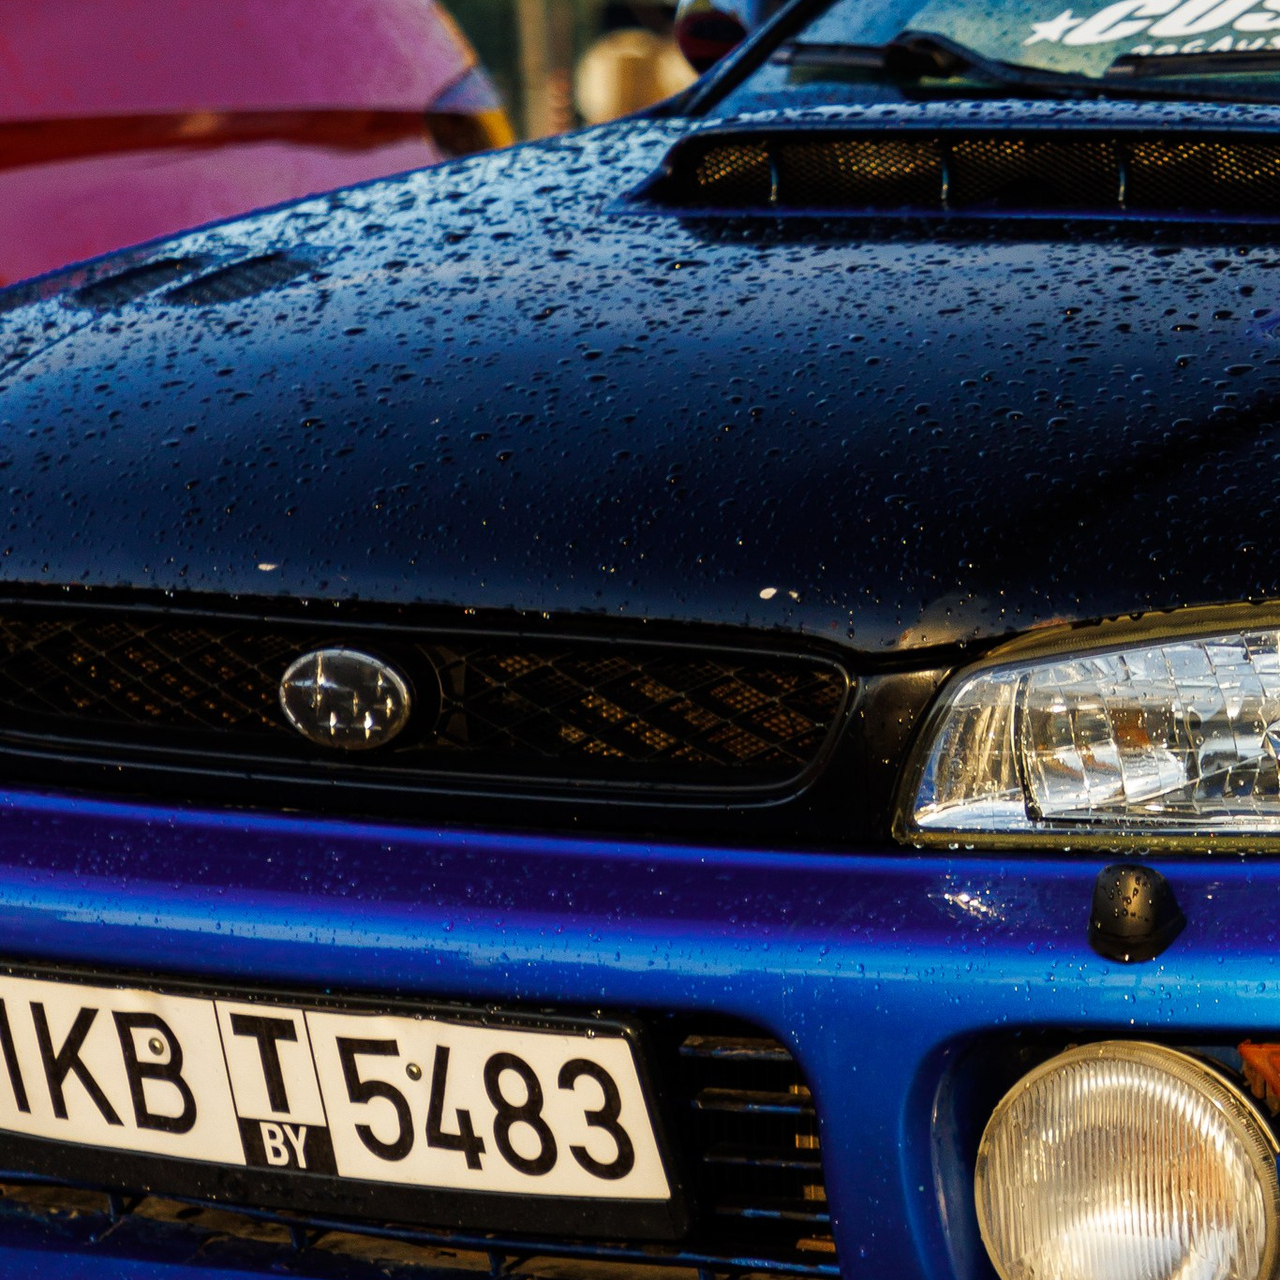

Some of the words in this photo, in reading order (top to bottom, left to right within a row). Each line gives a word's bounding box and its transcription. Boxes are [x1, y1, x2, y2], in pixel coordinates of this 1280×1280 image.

[232, 1016, 298, 1115] T
[335, 1035, 636, 1182] 5483
[263, 1123, 308, 1170] BY
